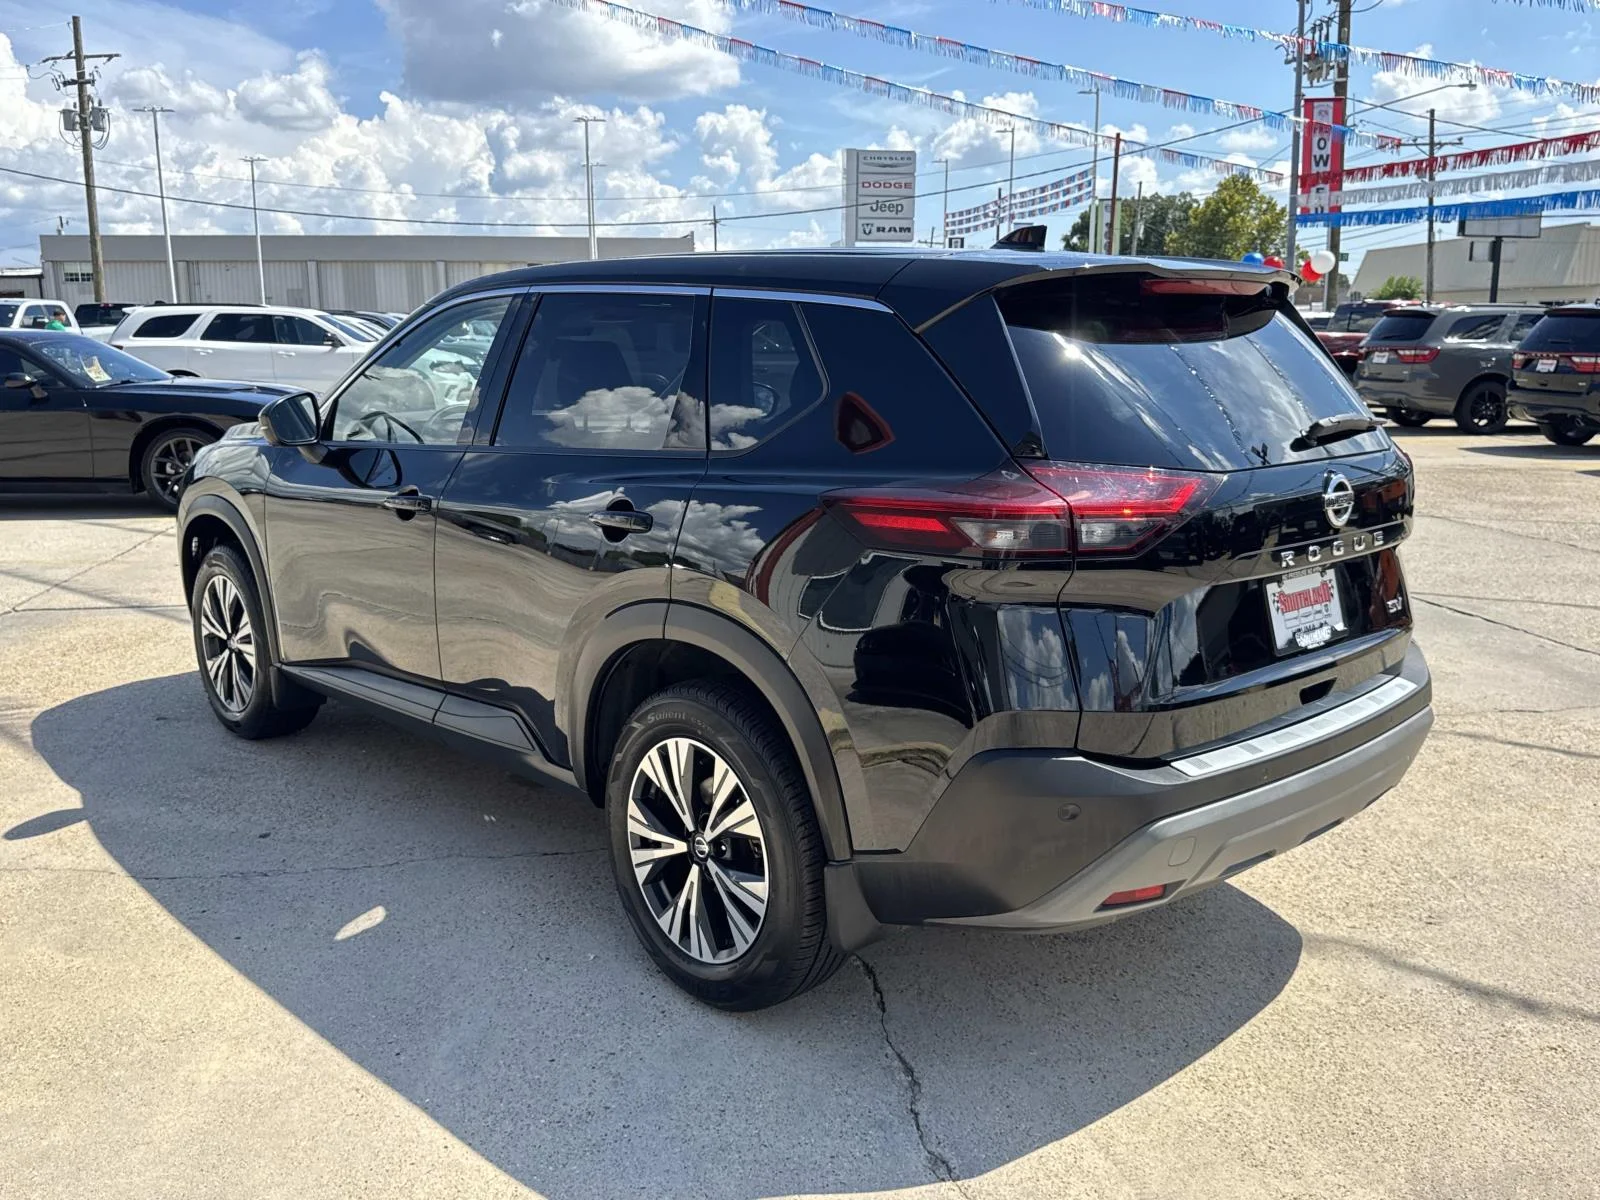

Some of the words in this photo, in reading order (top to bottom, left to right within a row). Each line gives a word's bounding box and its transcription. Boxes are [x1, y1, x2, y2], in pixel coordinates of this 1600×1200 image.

[862, 181, 912, 189] DODGE
[870, 200, 904, 215] Jeep
[1281, 531, 1384, 568] ROGUE
